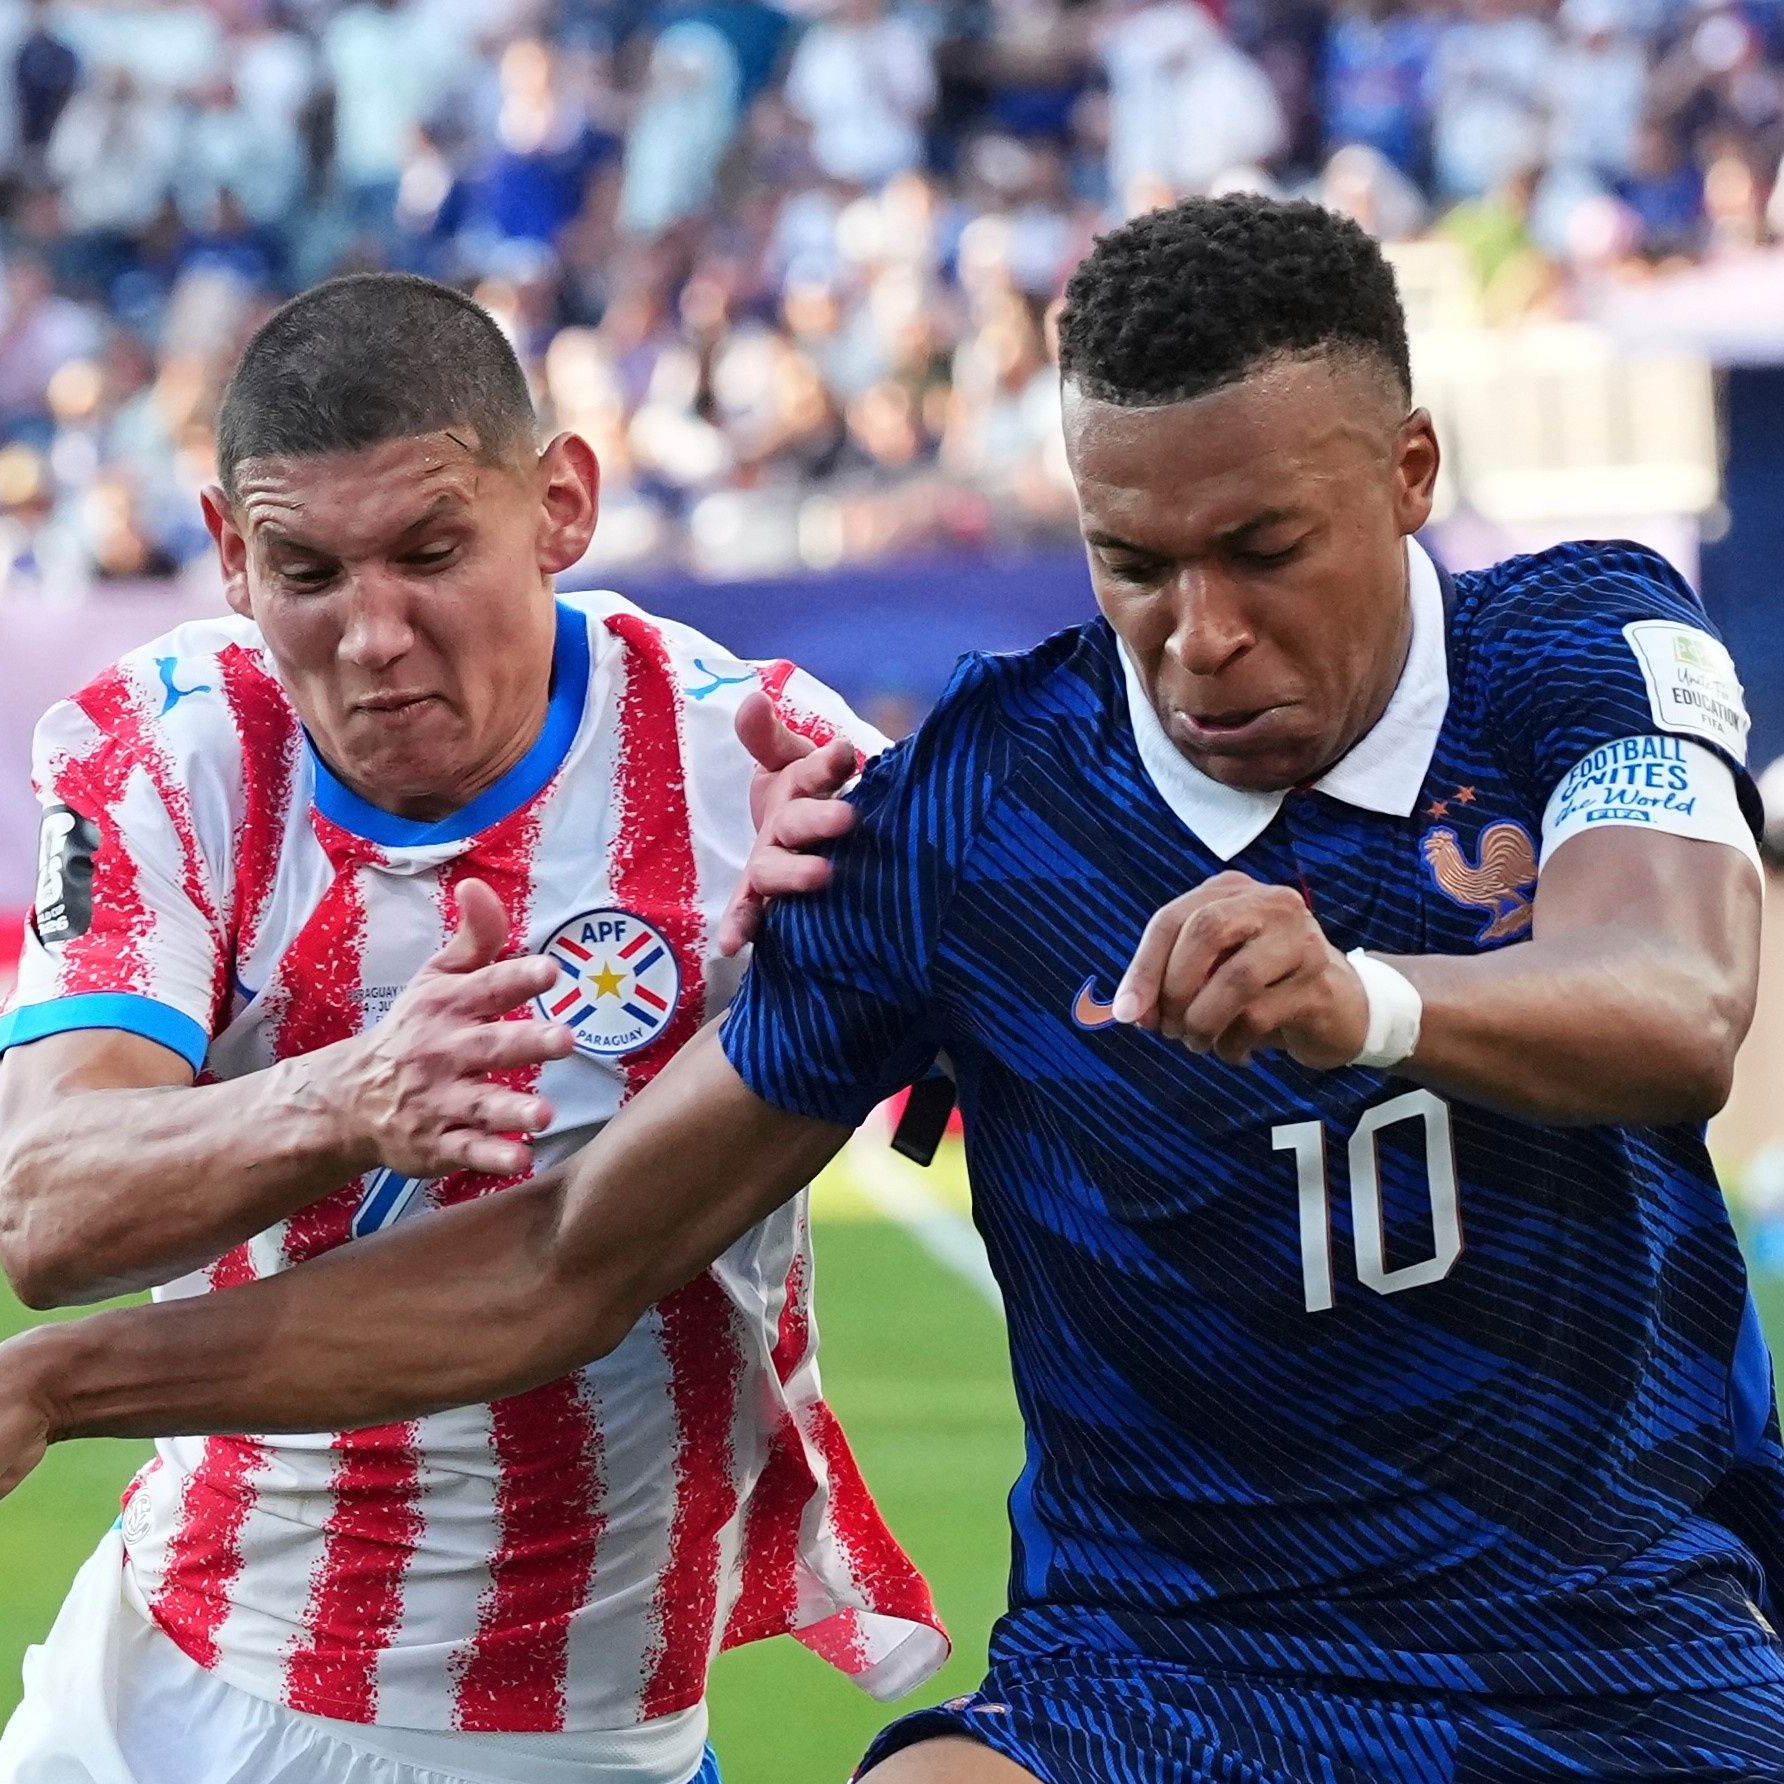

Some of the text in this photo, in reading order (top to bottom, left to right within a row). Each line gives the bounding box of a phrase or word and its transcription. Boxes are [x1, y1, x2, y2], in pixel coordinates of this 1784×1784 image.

[1673, 688, 1741, 731] EDUCATION
[1701, 714, 1725, 733] FIFA
[1568, 736, 1687, 785] FOOTBALL
[1561, 763, 1688, 802] UNITES
[1603, 787, 1696, 816] World
[580, 921, 626, 944] APF
[347, 986, 398, 999] PARAGUAY
[576, 1027, 644, 1046] PARAGUAY
[1271, 1088, 1463, 1312] 10
